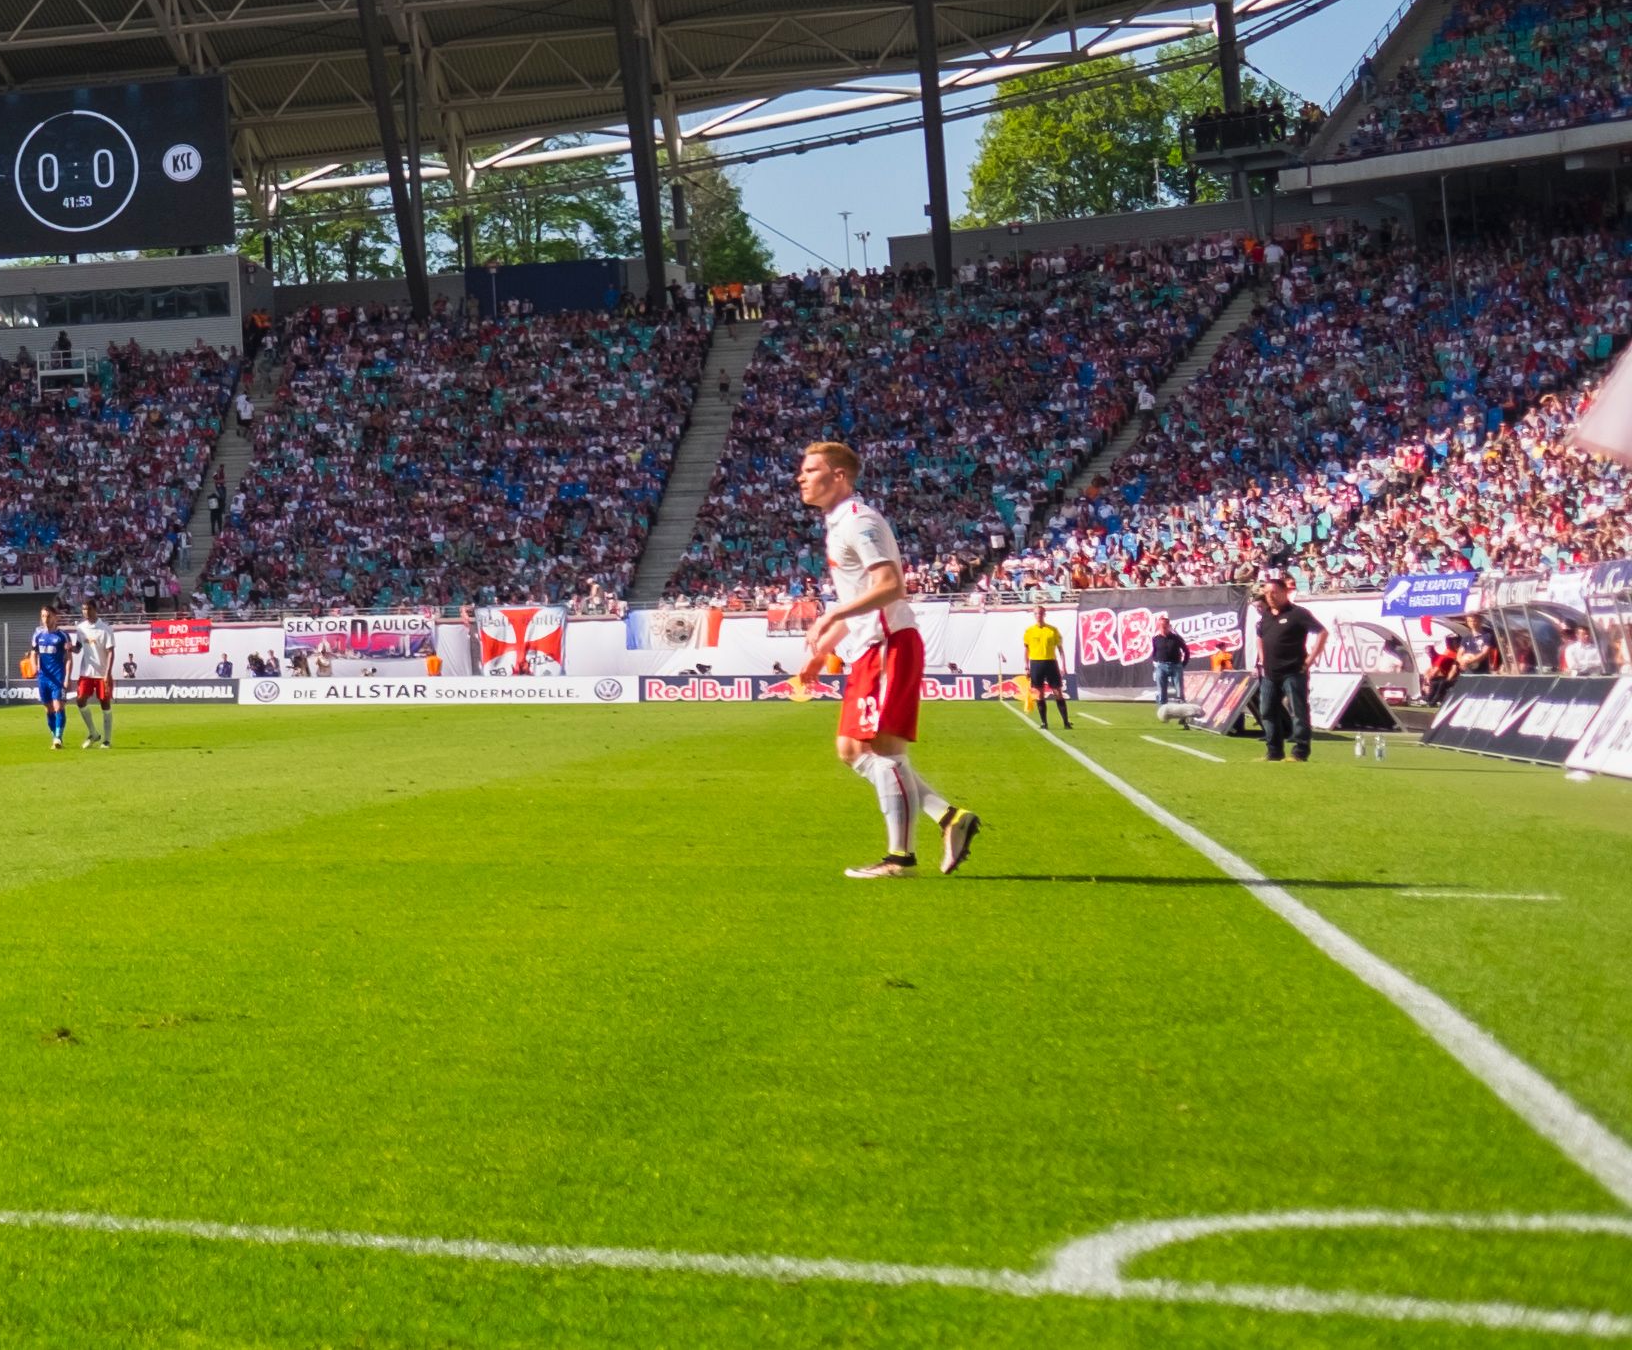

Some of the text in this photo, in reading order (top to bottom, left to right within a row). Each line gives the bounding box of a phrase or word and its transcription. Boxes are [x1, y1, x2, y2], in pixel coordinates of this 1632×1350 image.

[38, 153, 58, 192] 0
[93, 149, 114, 188] 0
[172, 152, 193, 173] KSC
[62, 196, 92, 208] 41:53
[287, 621, 348, 633] SEKTOR
[372, 618, 431, 631] AULIGK
[294, 690, 317, 698] DIE
[326, 685, 427, 698] ALLSTAR
[857, 696, 879, 727] 23
